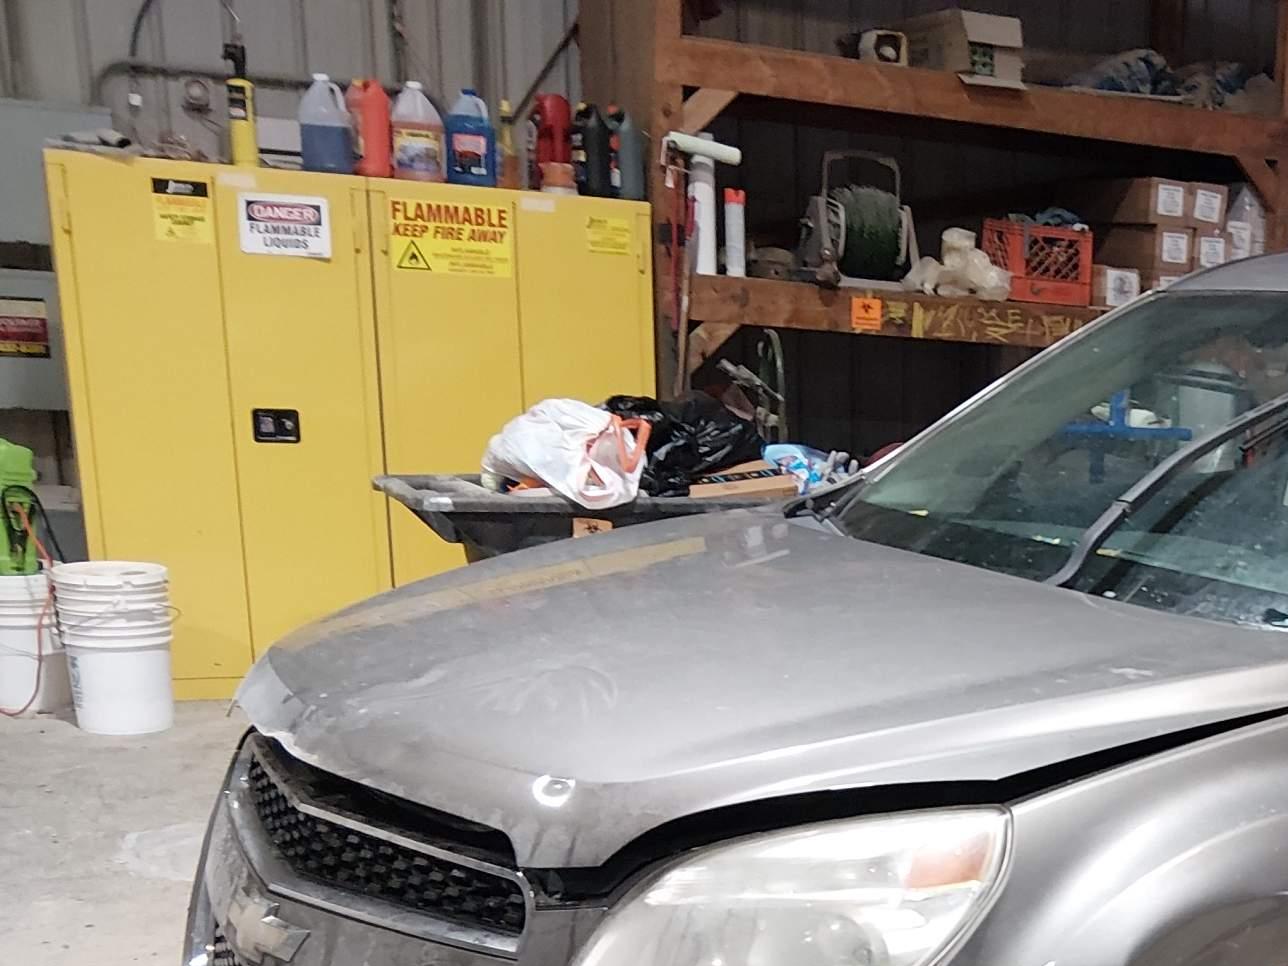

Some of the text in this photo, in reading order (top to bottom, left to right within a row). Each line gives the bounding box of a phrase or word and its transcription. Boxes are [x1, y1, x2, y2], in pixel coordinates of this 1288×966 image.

[252, 204, 316, 221] DANGER
[391, 200, 508, 228] FLAMMABLE
[248, 222, 322, 238] FLAMMABLE
[392, 223, 506, 243] KEEP FIRE AWAY
[263, 236, 310, 249] LIQUIDS
